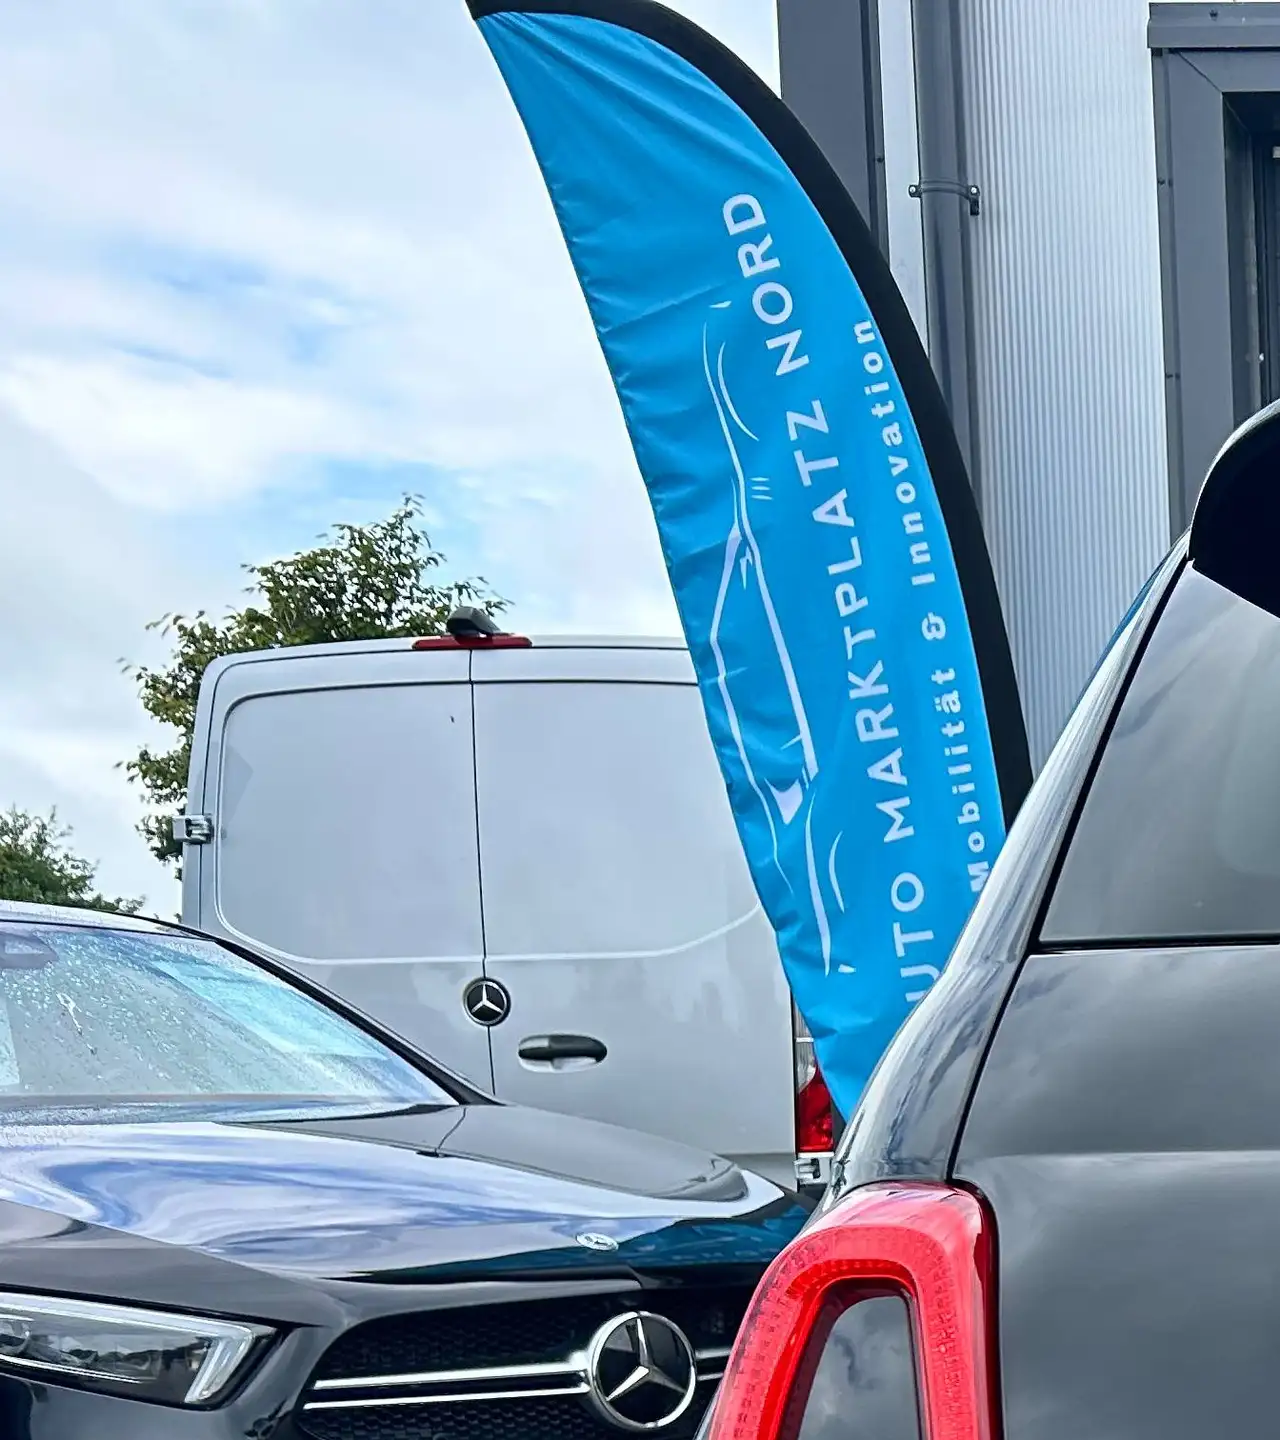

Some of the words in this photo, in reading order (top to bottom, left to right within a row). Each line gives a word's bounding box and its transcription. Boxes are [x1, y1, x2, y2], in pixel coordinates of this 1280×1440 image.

[722, 193, 810, 376] NORD
[853, 320, 936, 586] Innovation
[786, 399, 915, 843] MARKTPLATZ
[921, 611, 947, 641] &
[931, 667, 992, 893] Mobilität
[890, 872, 941, 1003] UTO
